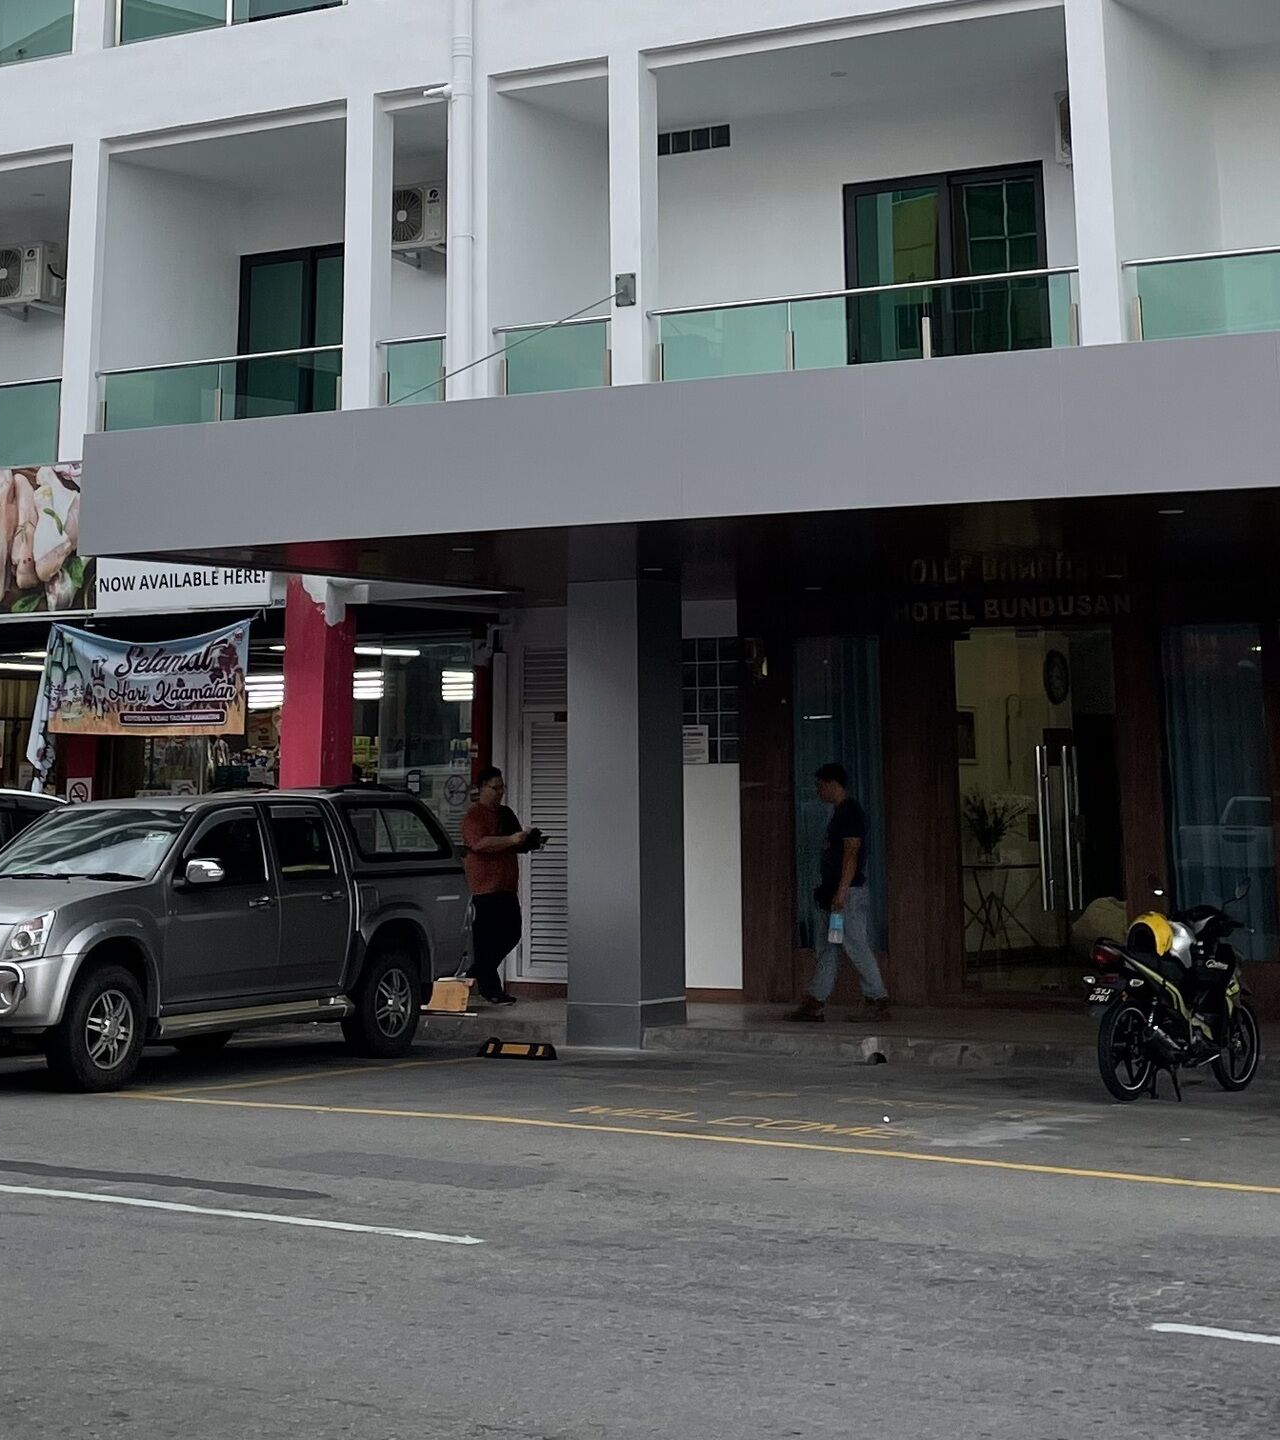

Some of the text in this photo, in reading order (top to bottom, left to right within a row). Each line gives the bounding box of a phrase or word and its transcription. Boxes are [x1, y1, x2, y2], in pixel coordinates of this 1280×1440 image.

[99, 568, 266, 592] NOW AVAILABLE HERE!
[895, 593, 1132, 623] HOTEL BUNDUSAN
[114, 639, 228, 677] Selamat
[109, 680, 149, 702] Hari
[153, 679, 237, 708] Kaamatan
